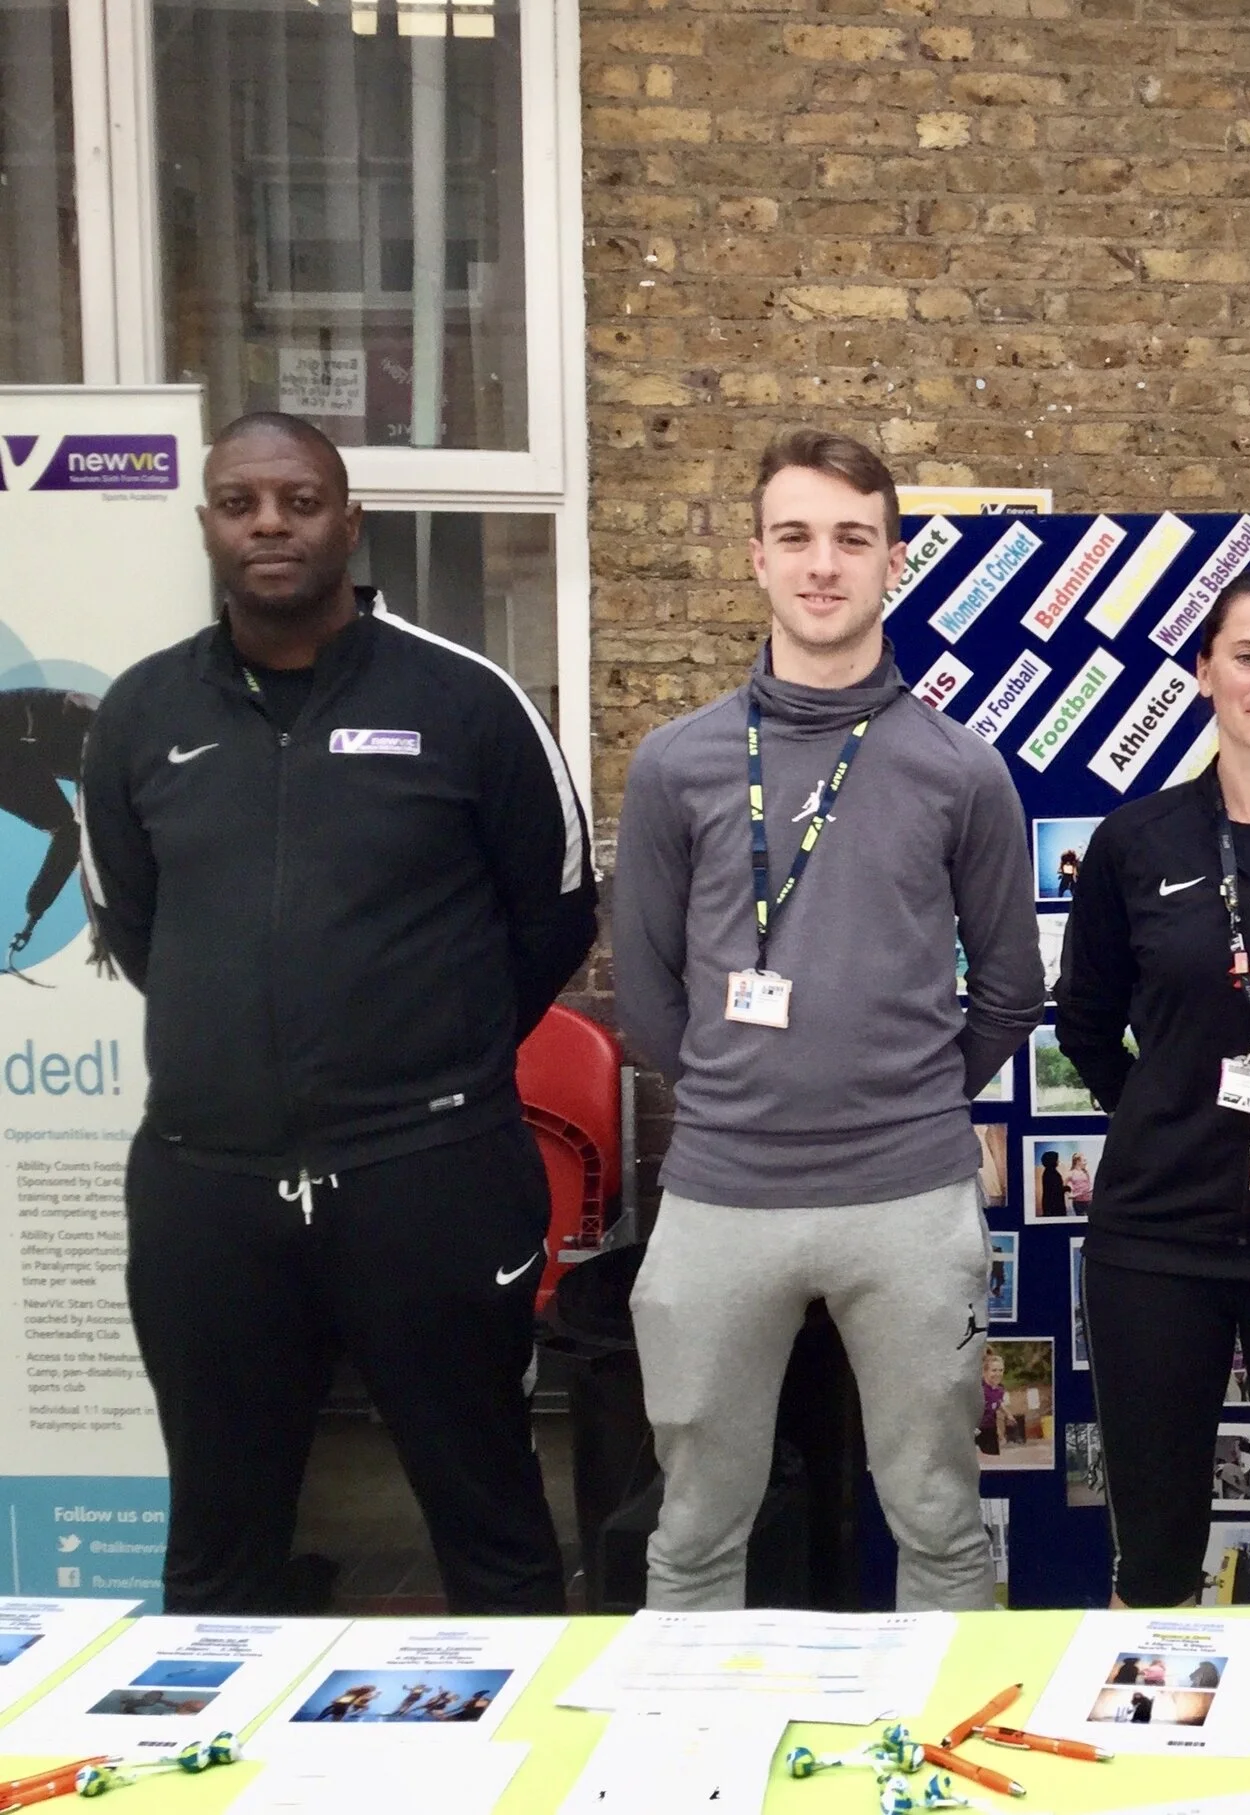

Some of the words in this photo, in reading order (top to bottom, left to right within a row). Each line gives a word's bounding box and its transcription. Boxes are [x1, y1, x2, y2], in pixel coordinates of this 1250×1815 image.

[68, 452, 169, 472] newvic
[937, 576, 997, 636] Women's
[986, 531, 1035, 584] Cricket
[1033, 532, 1116, 630] Badminton
[1155, 590, 1210, 648] Women's
[986, 659, 1040, 718] Football
[1027, 665, 1108, 760] Football
[1109, 677, 1187, 773] Athletics
[829, 761, 848, 791] STAFF
[4, 1038, 121, 1096] ded!
[54, 1505, 113, 1523] Follow
[117, 1509, 138, 1523] us
[141, 1509, 165, 1523] on
